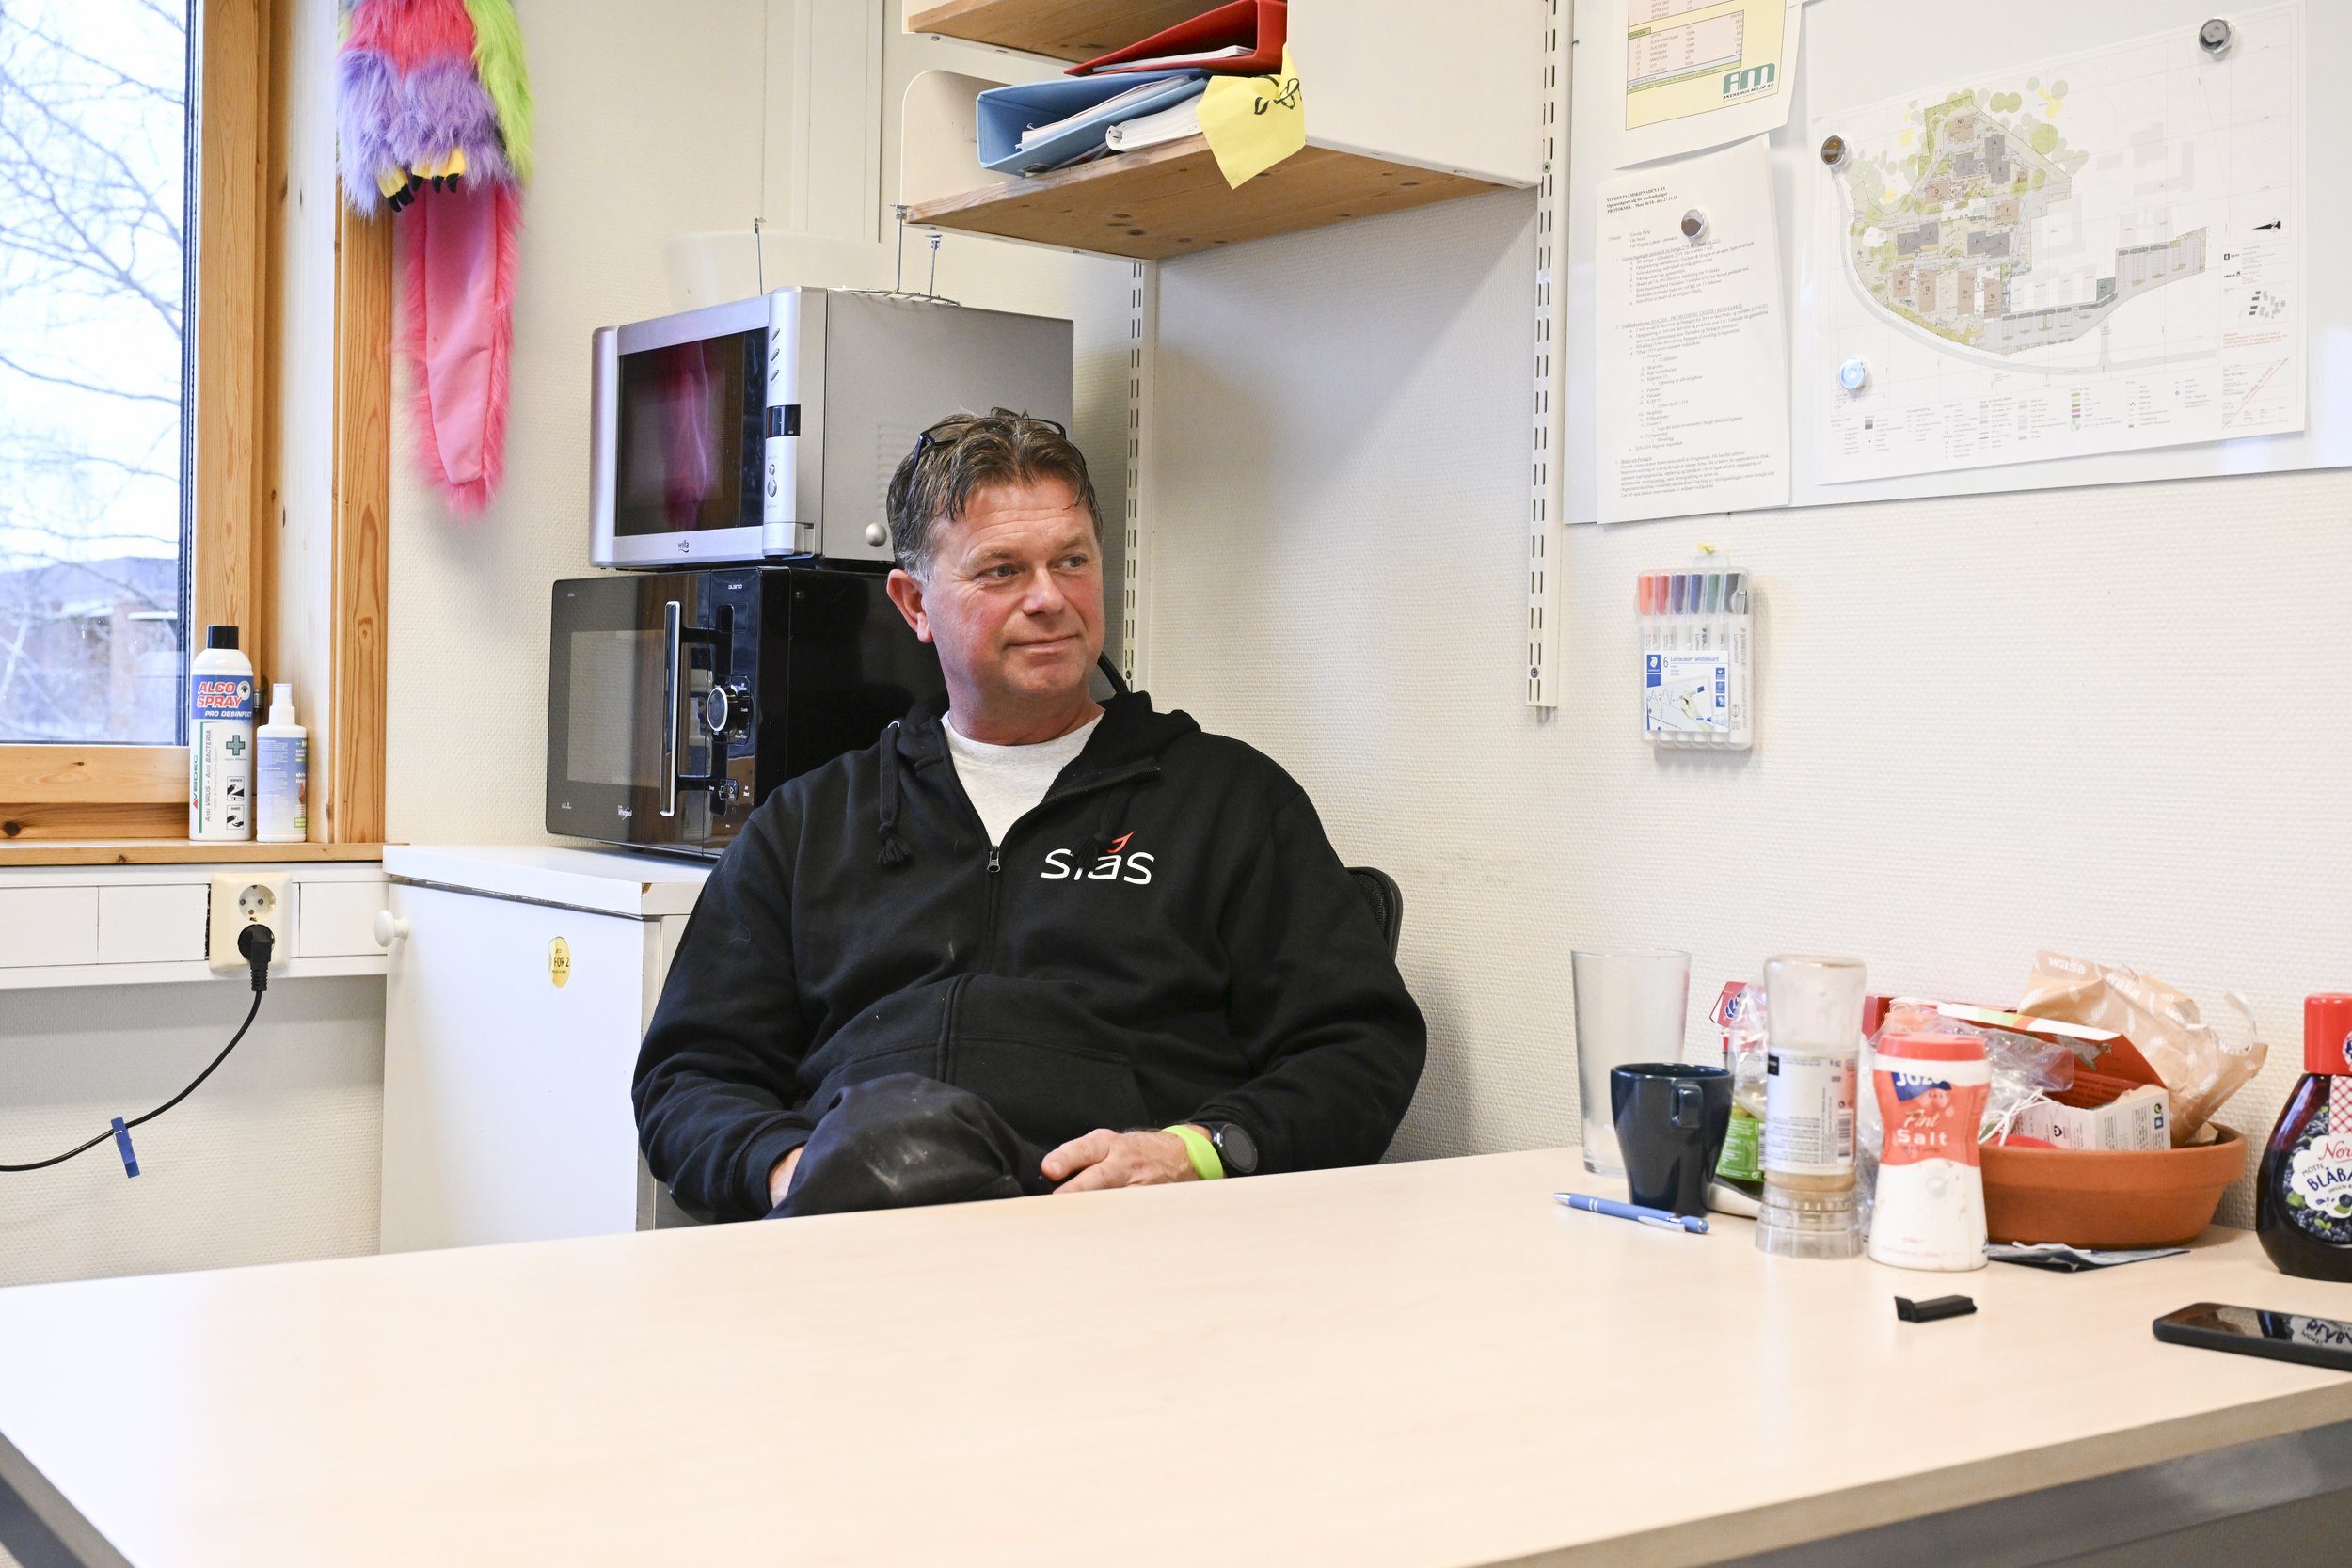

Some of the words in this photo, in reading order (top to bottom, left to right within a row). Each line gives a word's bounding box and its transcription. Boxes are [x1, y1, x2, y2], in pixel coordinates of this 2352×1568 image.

[1663, 656, 1669, 668] 6
[198, 681, 236, 695] ALCO
[197, 694, 243, 708] SPRAY
[553, 957, 564, 968] FOR
[565, 957, 570, 967] 2
[2047, 956, 2086, 975] wasa
[2106, 973, 2140, 999] wasa
[1903, 1108, 1941, 1128] Fint
[1896, 1129, 1948, 1146] Salt
